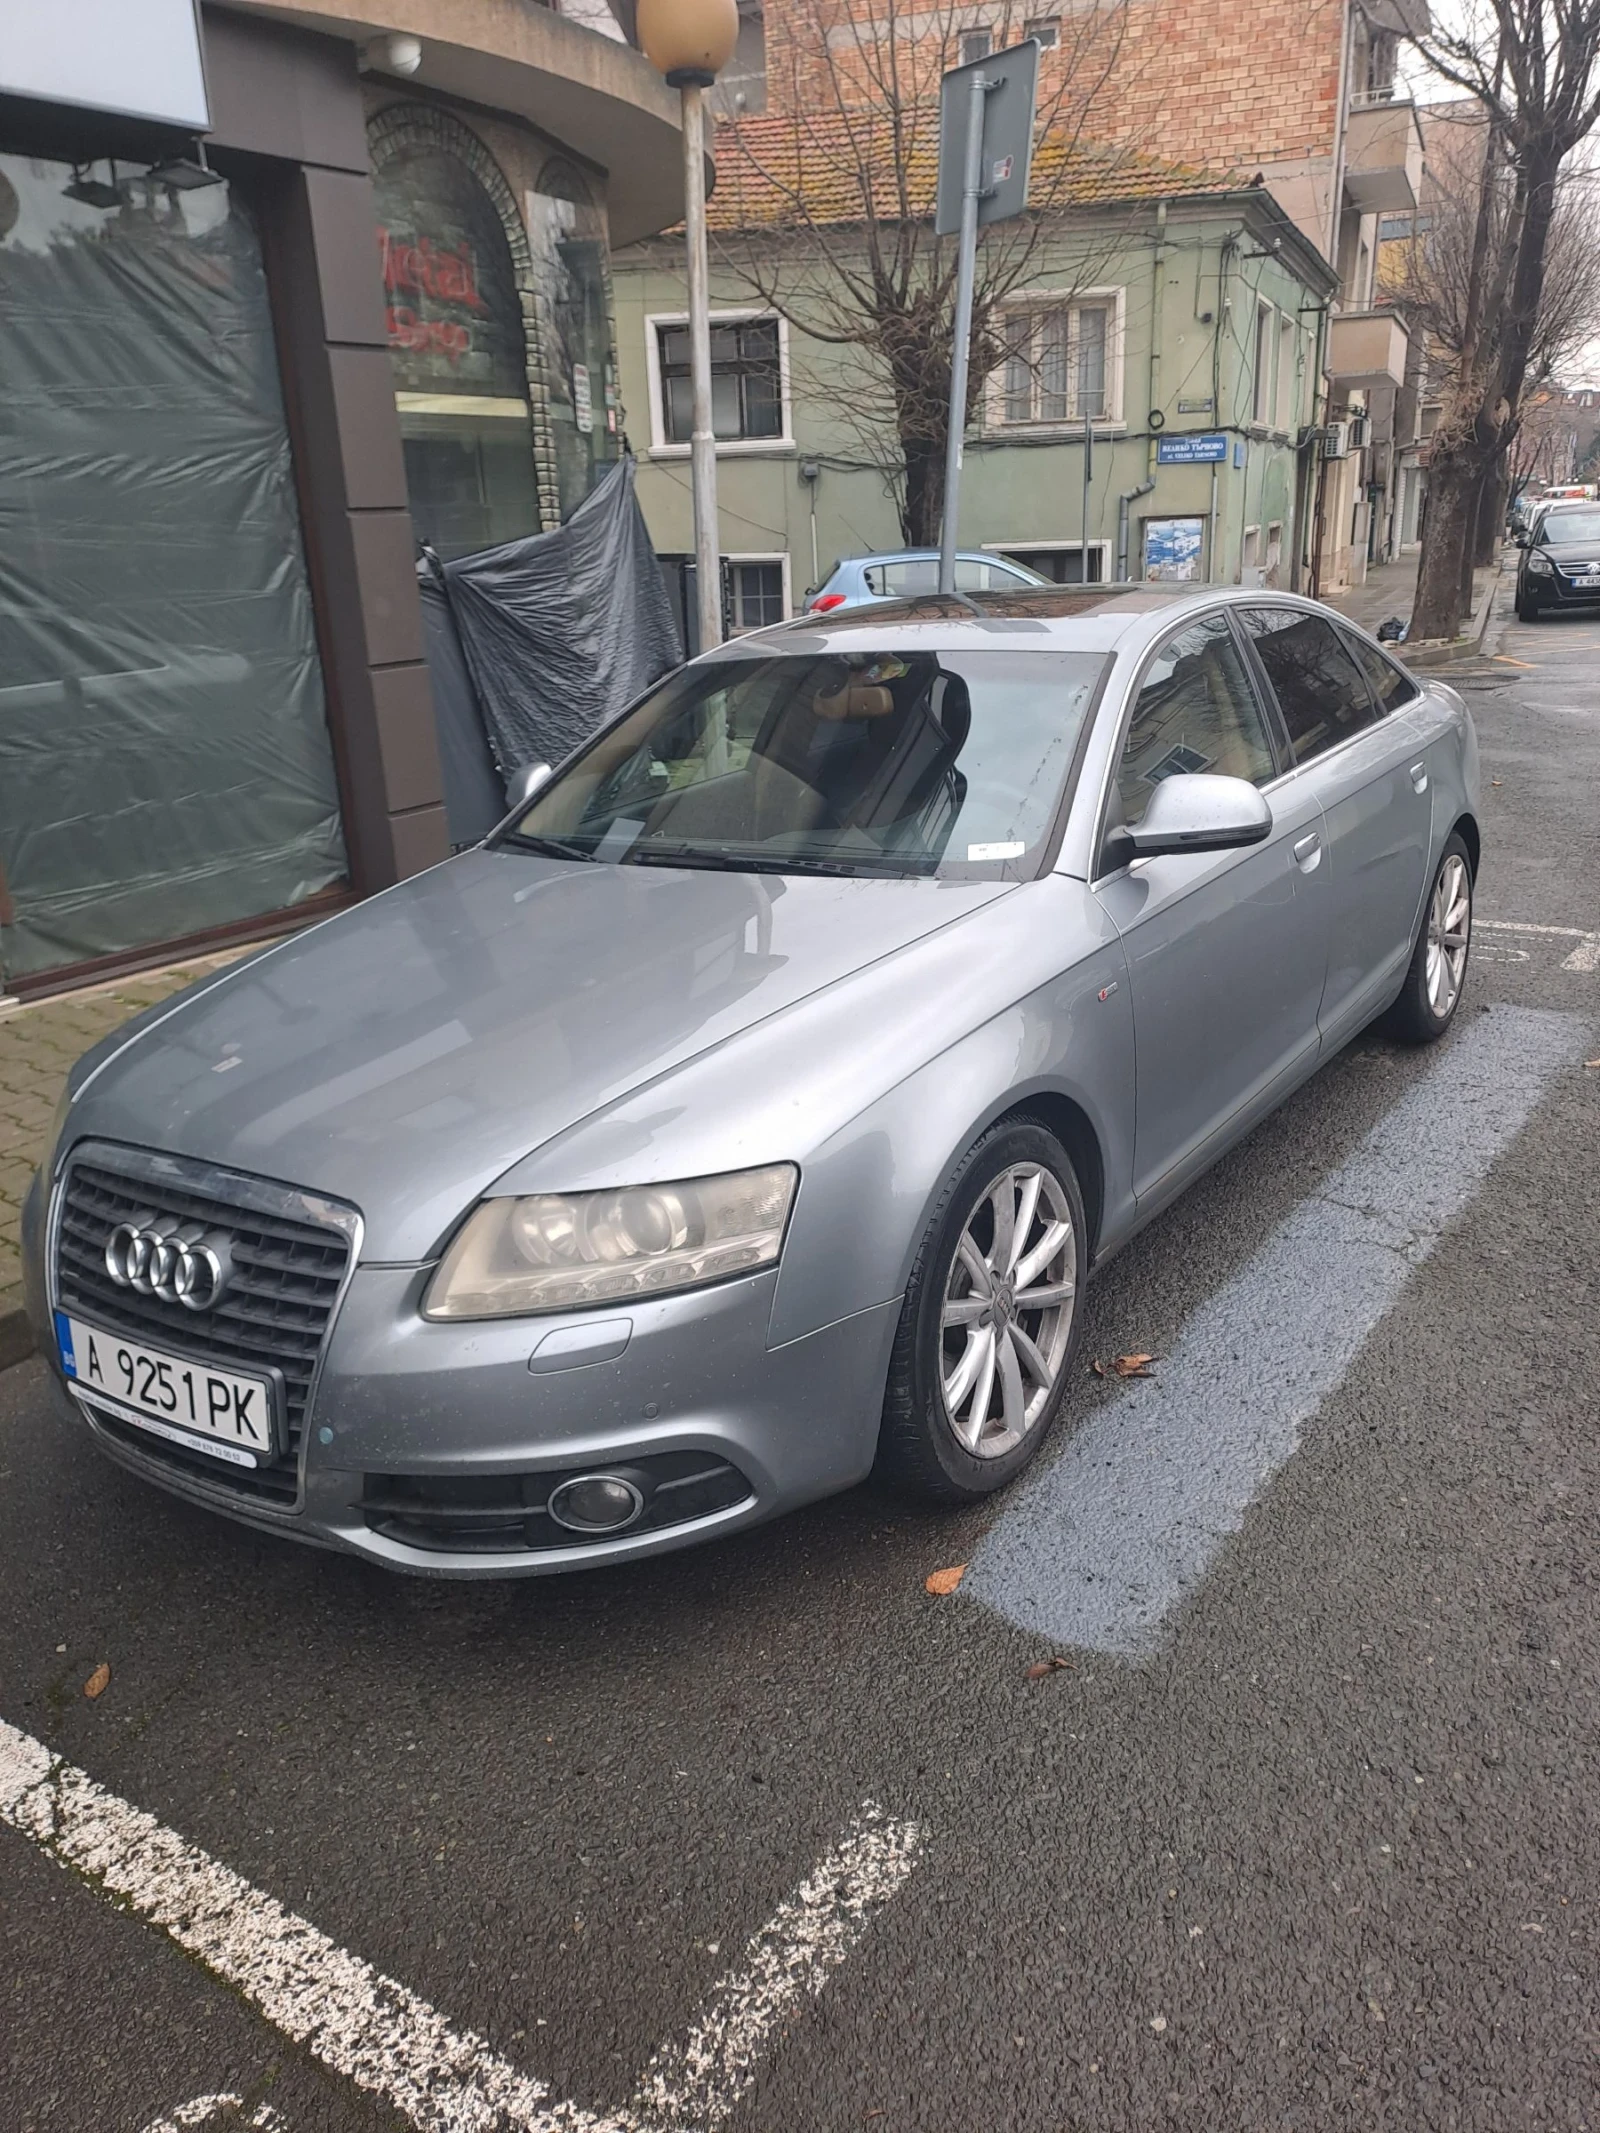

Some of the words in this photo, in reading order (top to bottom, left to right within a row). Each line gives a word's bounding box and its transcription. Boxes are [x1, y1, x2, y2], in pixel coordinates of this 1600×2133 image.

[88, 1334, 104, 1384] A
[117, 1348, 197, 1420] 9251
[207, 1377, 260, 1440] PK
